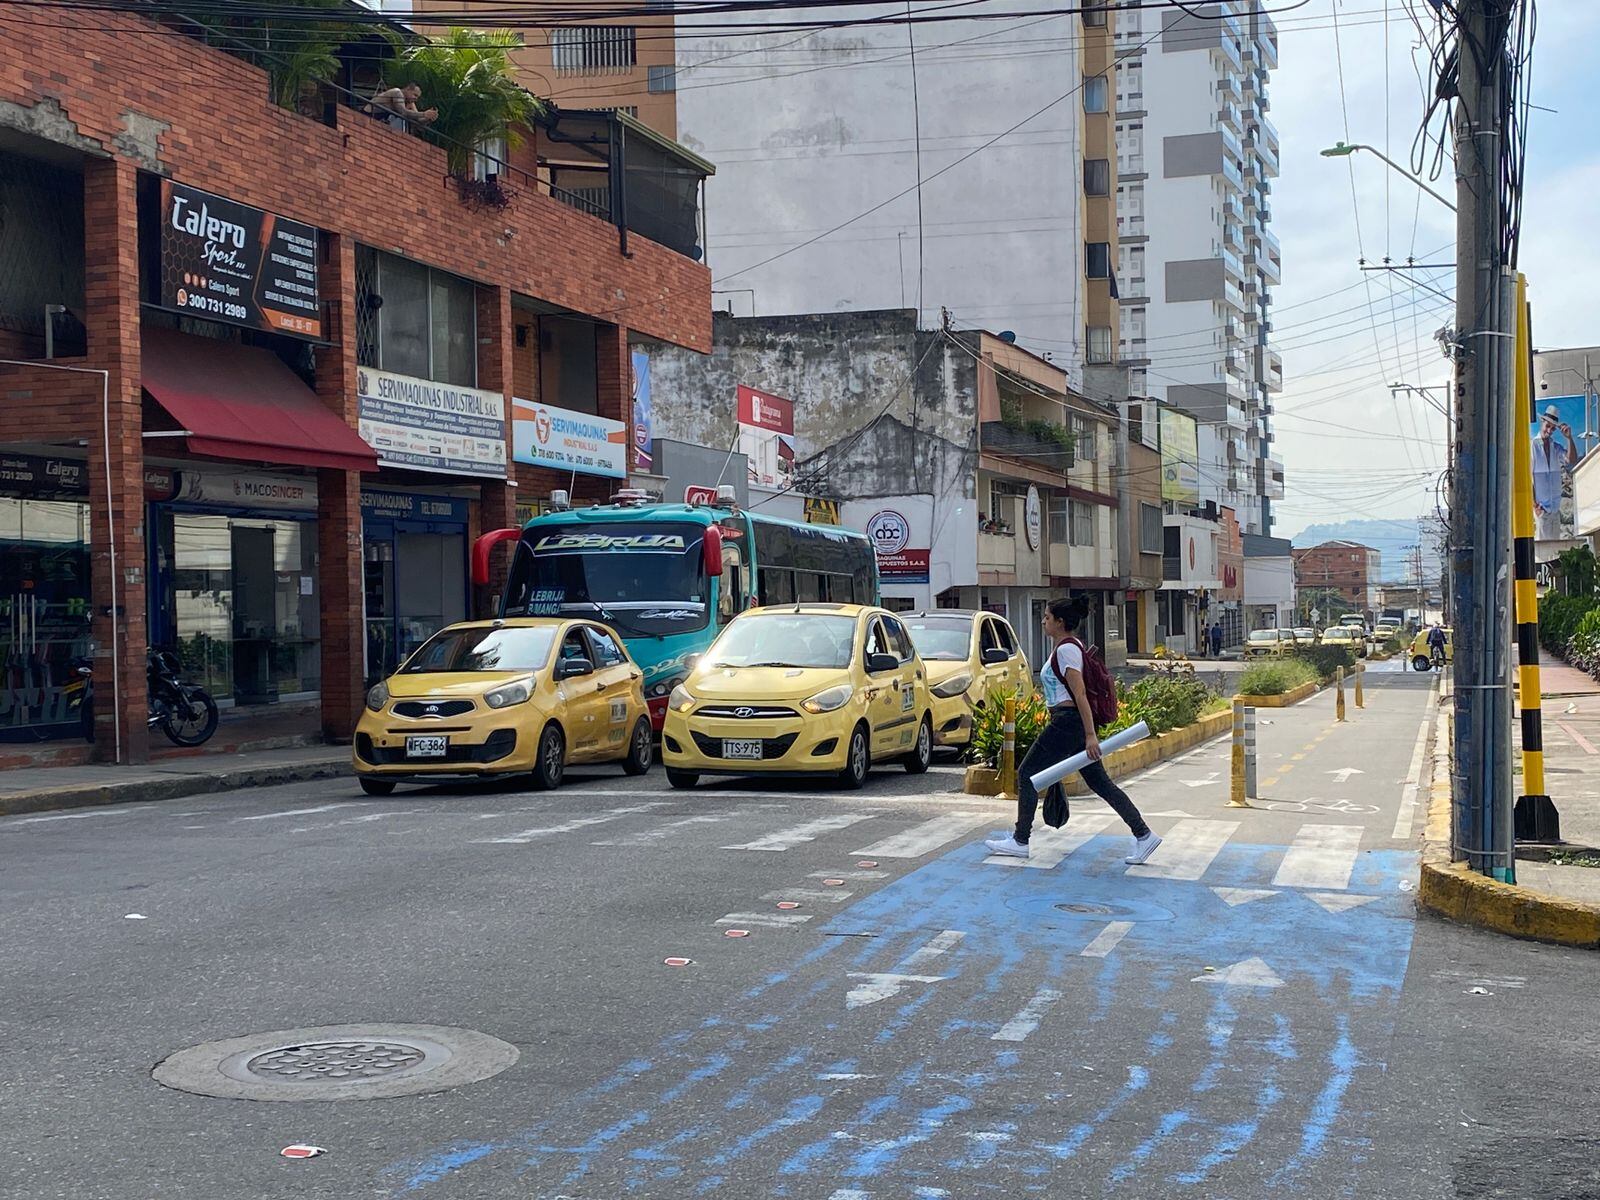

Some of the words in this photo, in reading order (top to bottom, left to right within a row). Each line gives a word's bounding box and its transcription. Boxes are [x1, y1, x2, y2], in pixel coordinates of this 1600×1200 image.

[172, 195, 245, 248] Calero
[189, 293, 206, 309] 300
[207, 298, 223, 314] 731
[225, 302, 247, 319] 2989
[378, 377, 441, 408] SERVIMAQUINAS
[443, 390, 483, 416] INDUSTRIAL
[551, 418, 607, 441] SERVIMAQUINAS
[46, 461, 79, 477] Calero
[244, 483, 304, 500] MACOSINGER
[360, 492, 413, 510] SERVIMAQUINAS
[875, 522, 900, 539] abc
[534, 534, 685, 551] LEBRIJA
[531, 590, 566, 602] LEBRIJA
[724, 742, 761, 754] TTS-975
